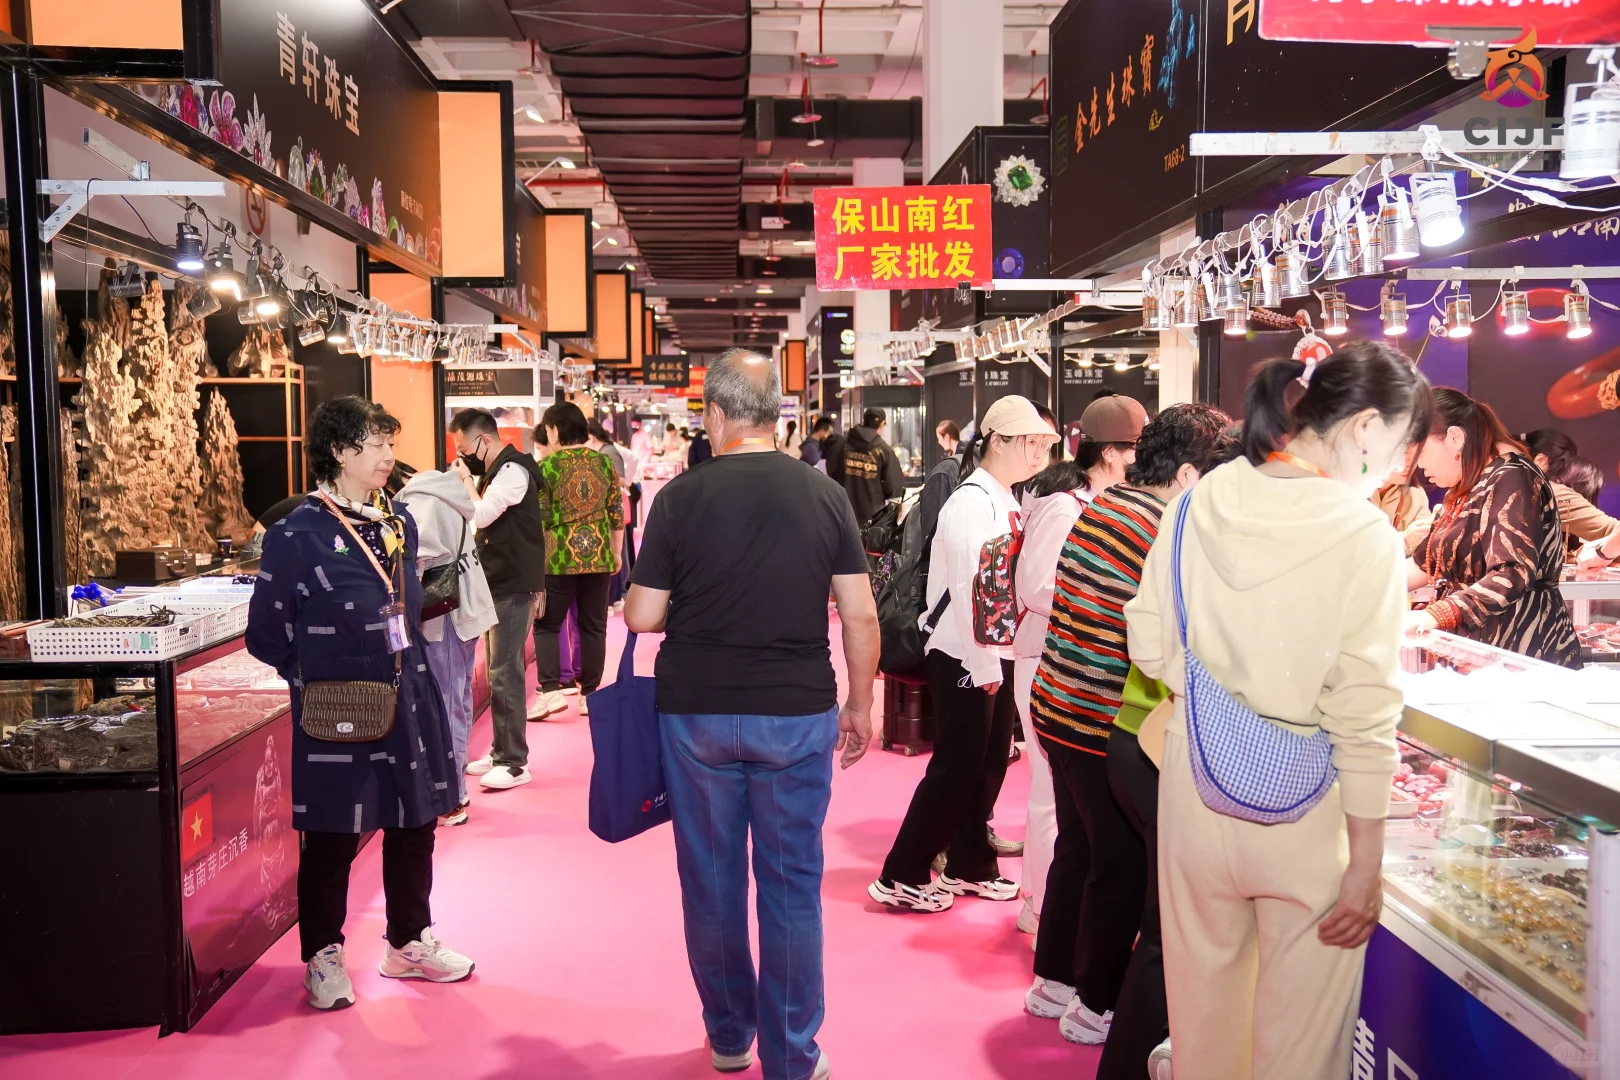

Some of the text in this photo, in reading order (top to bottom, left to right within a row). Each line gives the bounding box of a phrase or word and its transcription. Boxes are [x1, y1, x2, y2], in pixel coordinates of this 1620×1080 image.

[276, 10, 360, 136] 青轩珠宝
[831, 195, 975, 235] 保山南红
[833, 240, 975, 281] 厂家批发
[183, 827, 249, 897] 越南芽庄沉香
